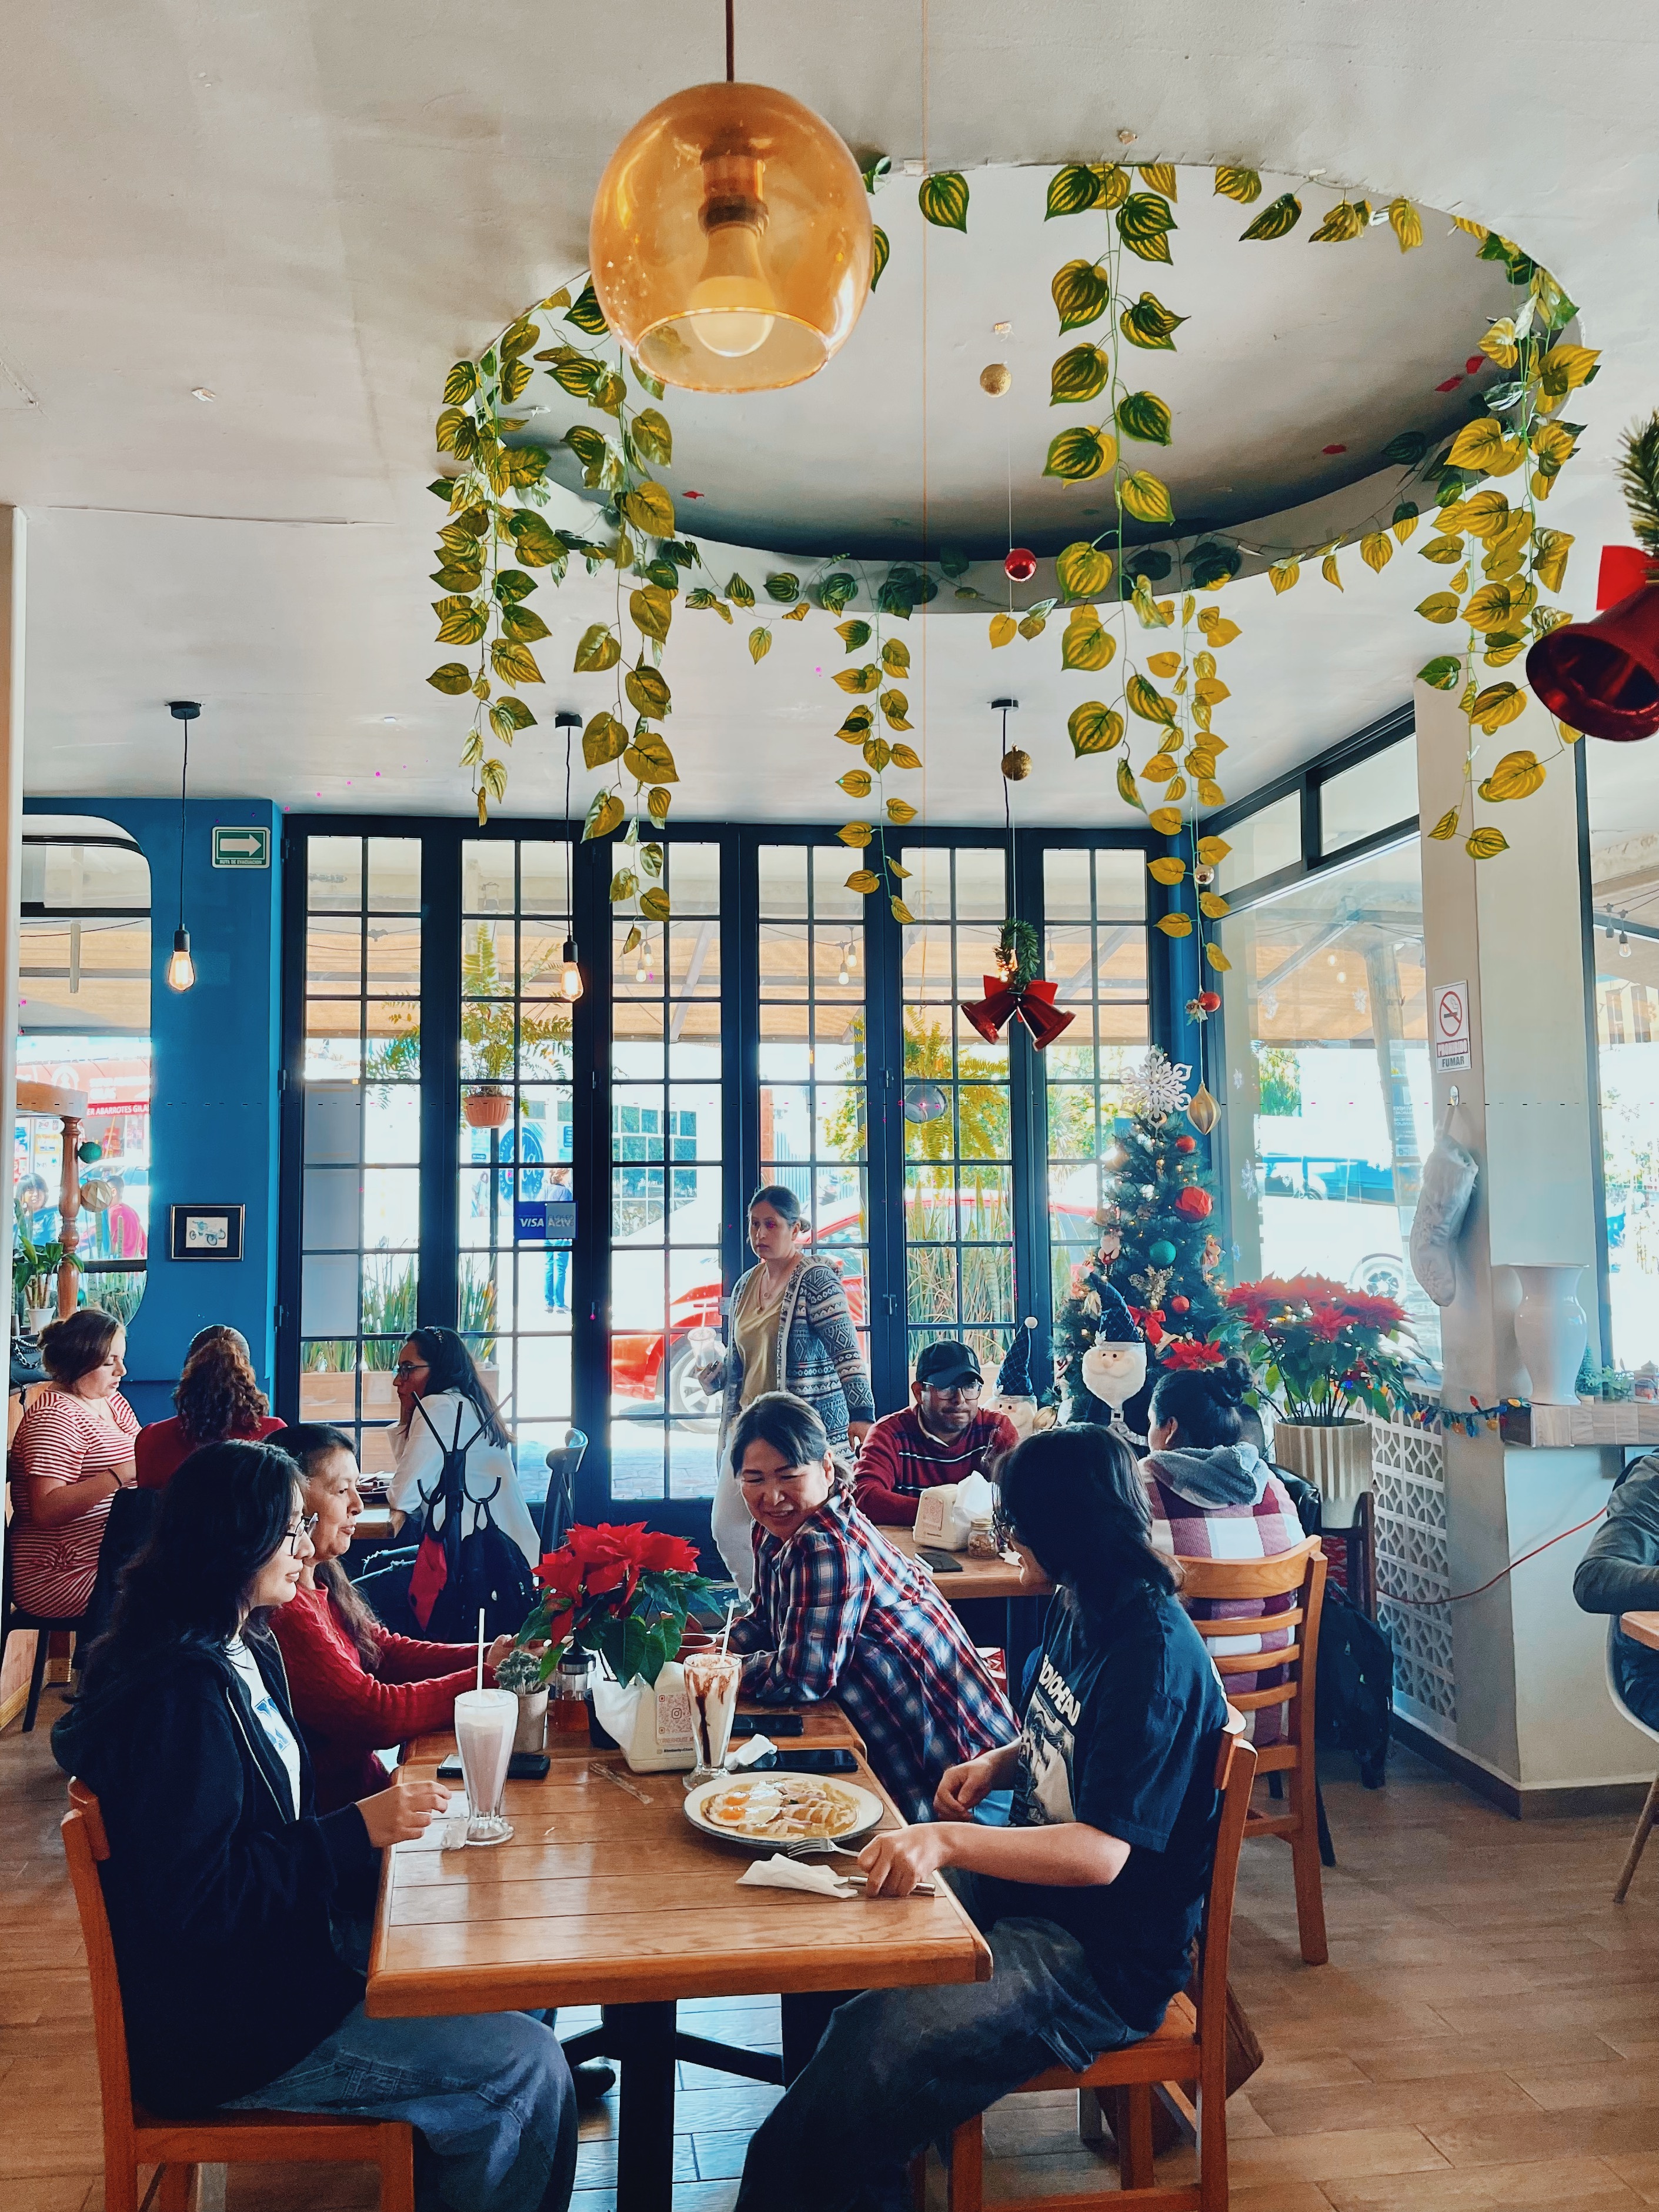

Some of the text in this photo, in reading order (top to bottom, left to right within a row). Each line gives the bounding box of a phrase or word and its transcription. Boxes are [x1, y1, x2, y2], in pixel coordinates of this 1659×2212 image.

[1437, 1039, 1467, 1056] PROHIBIDO
[1442, 1056, 1464, 1067] FUMAR
[95, 1106, 132, 1115] ABARROTES
[519, 1218, 545, 1227] VISA
